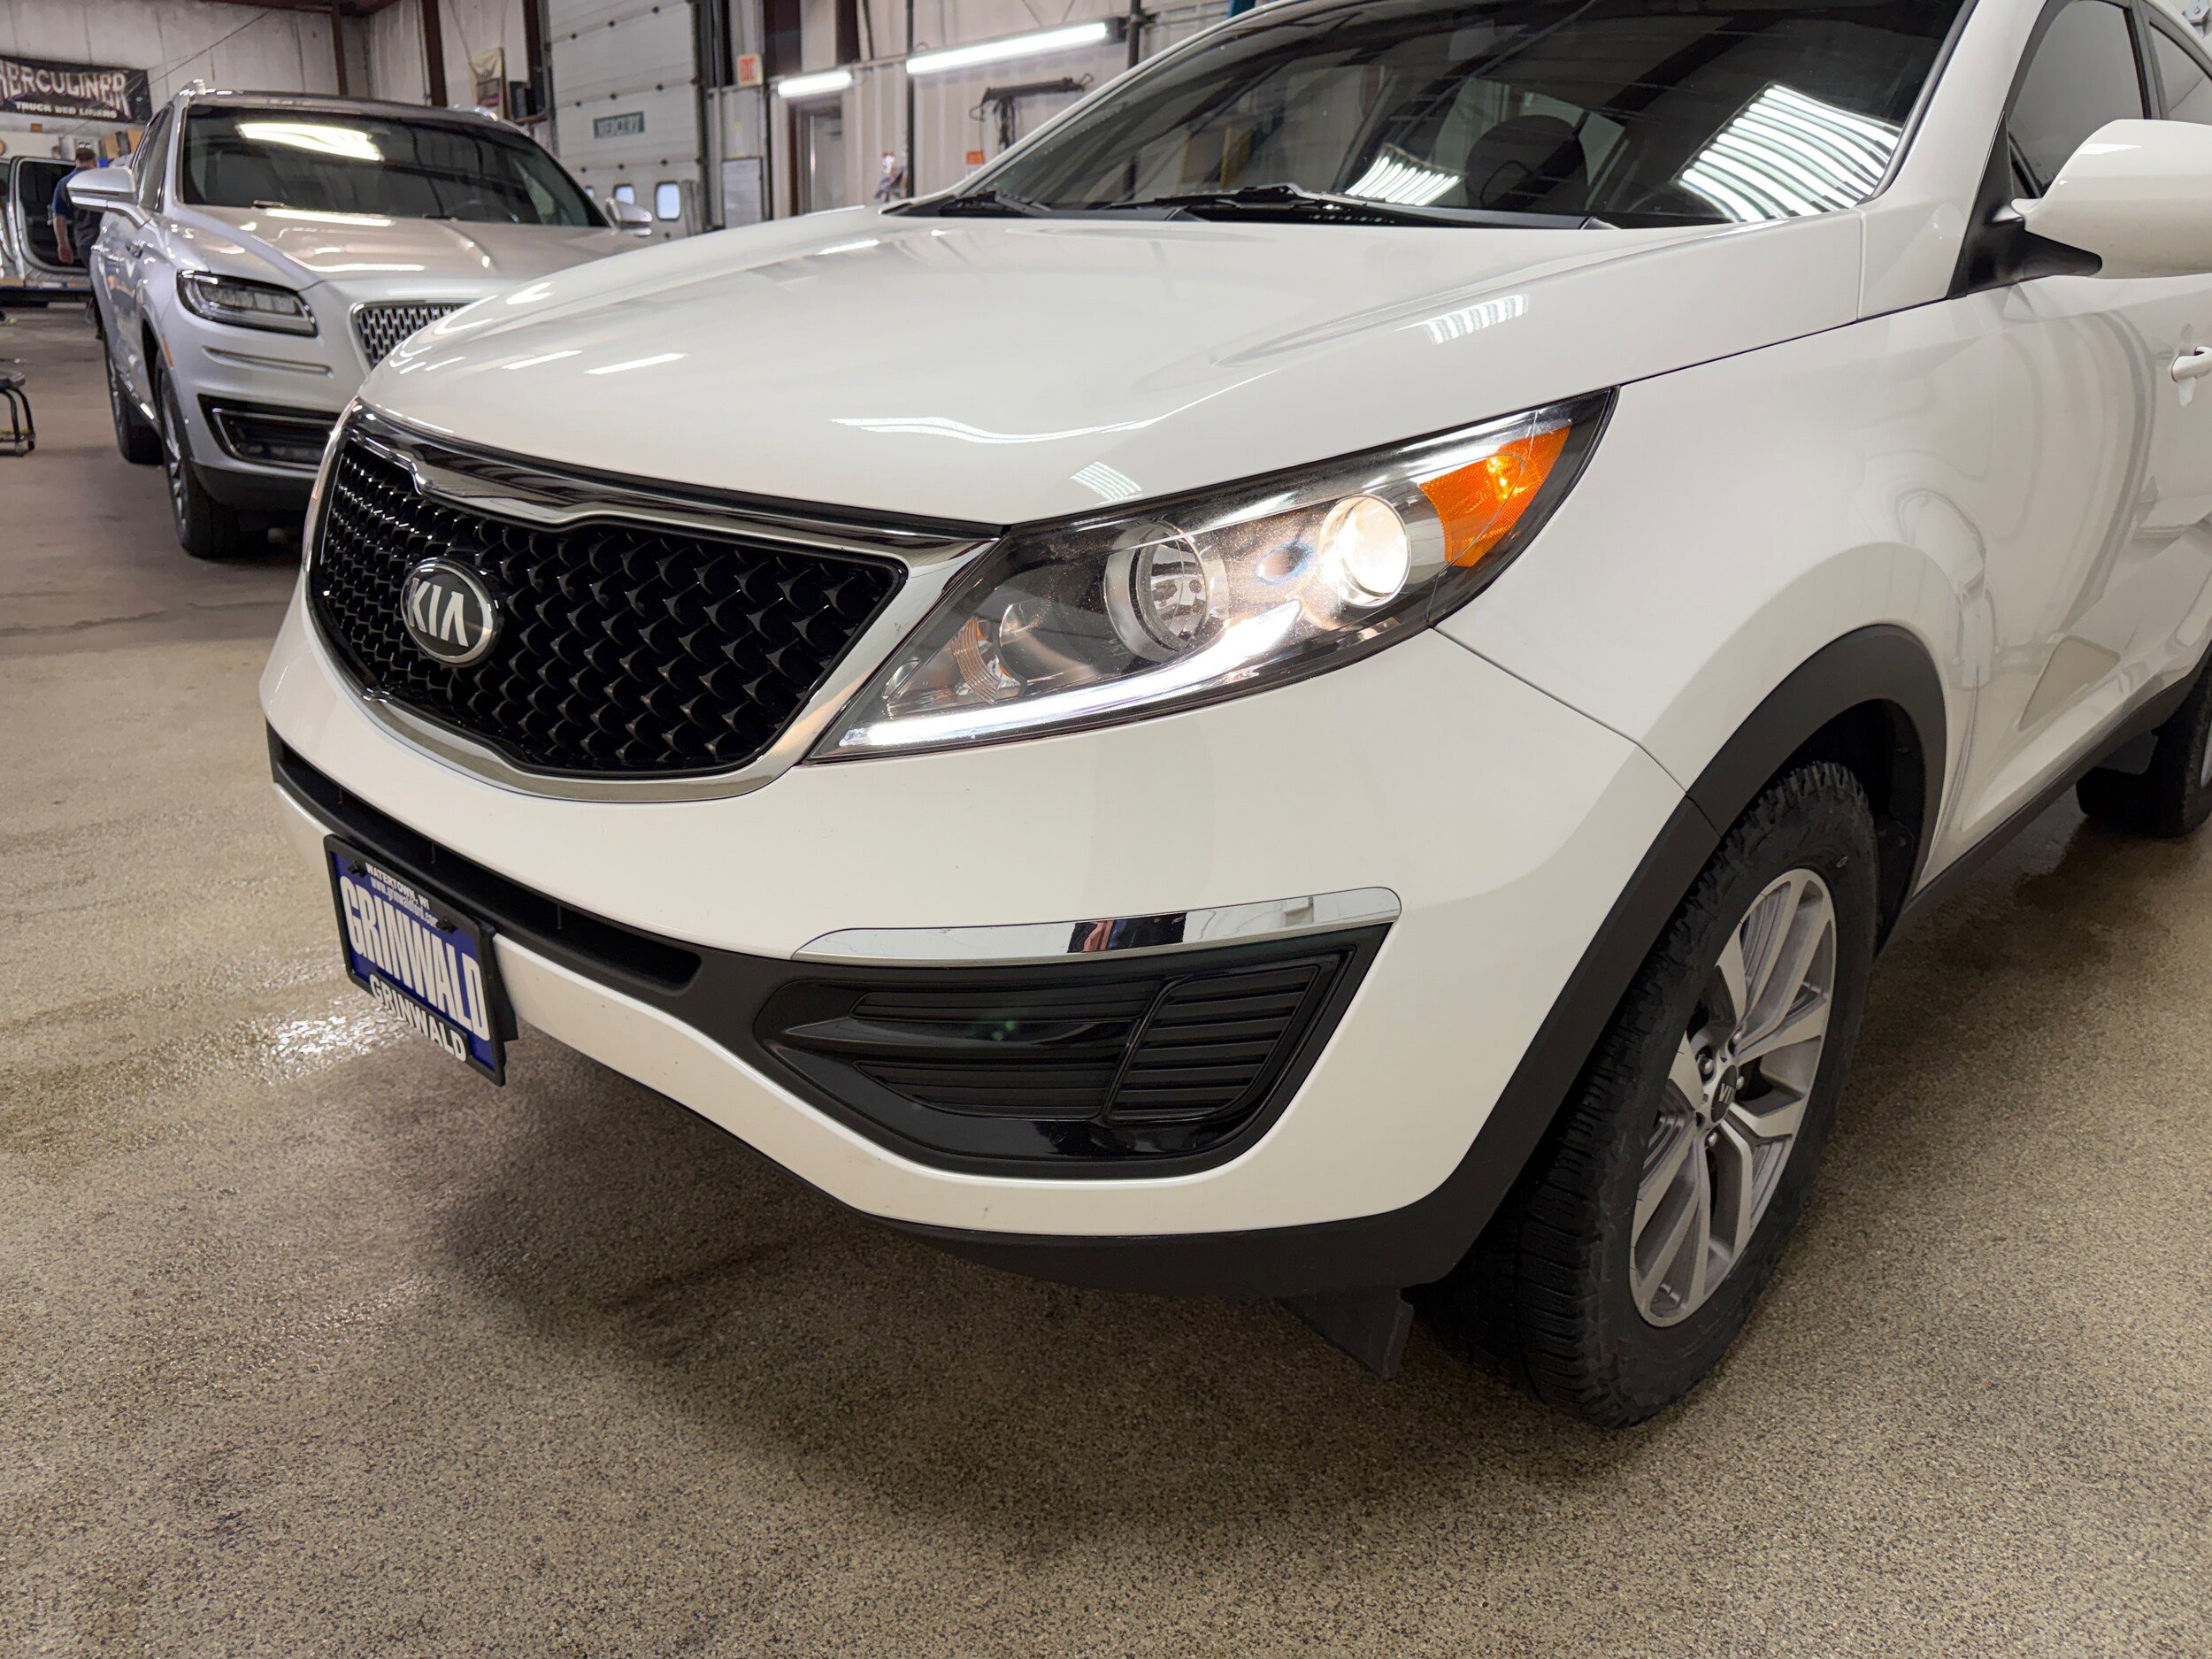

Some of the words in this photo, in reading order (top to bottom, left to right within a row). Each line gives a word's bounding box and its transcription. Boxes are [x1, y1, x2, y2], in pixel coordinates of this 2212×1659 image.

[14, 101, 52, 113] TRUCK
[54, 105, 77, 116] BED
[79, 107, 118, 119] LINERS
[407, 577, 469, 647] KIA
[340, 875, 490, 1041] GRINWALD
[369, 973, 467, 1062] GRINWALD
